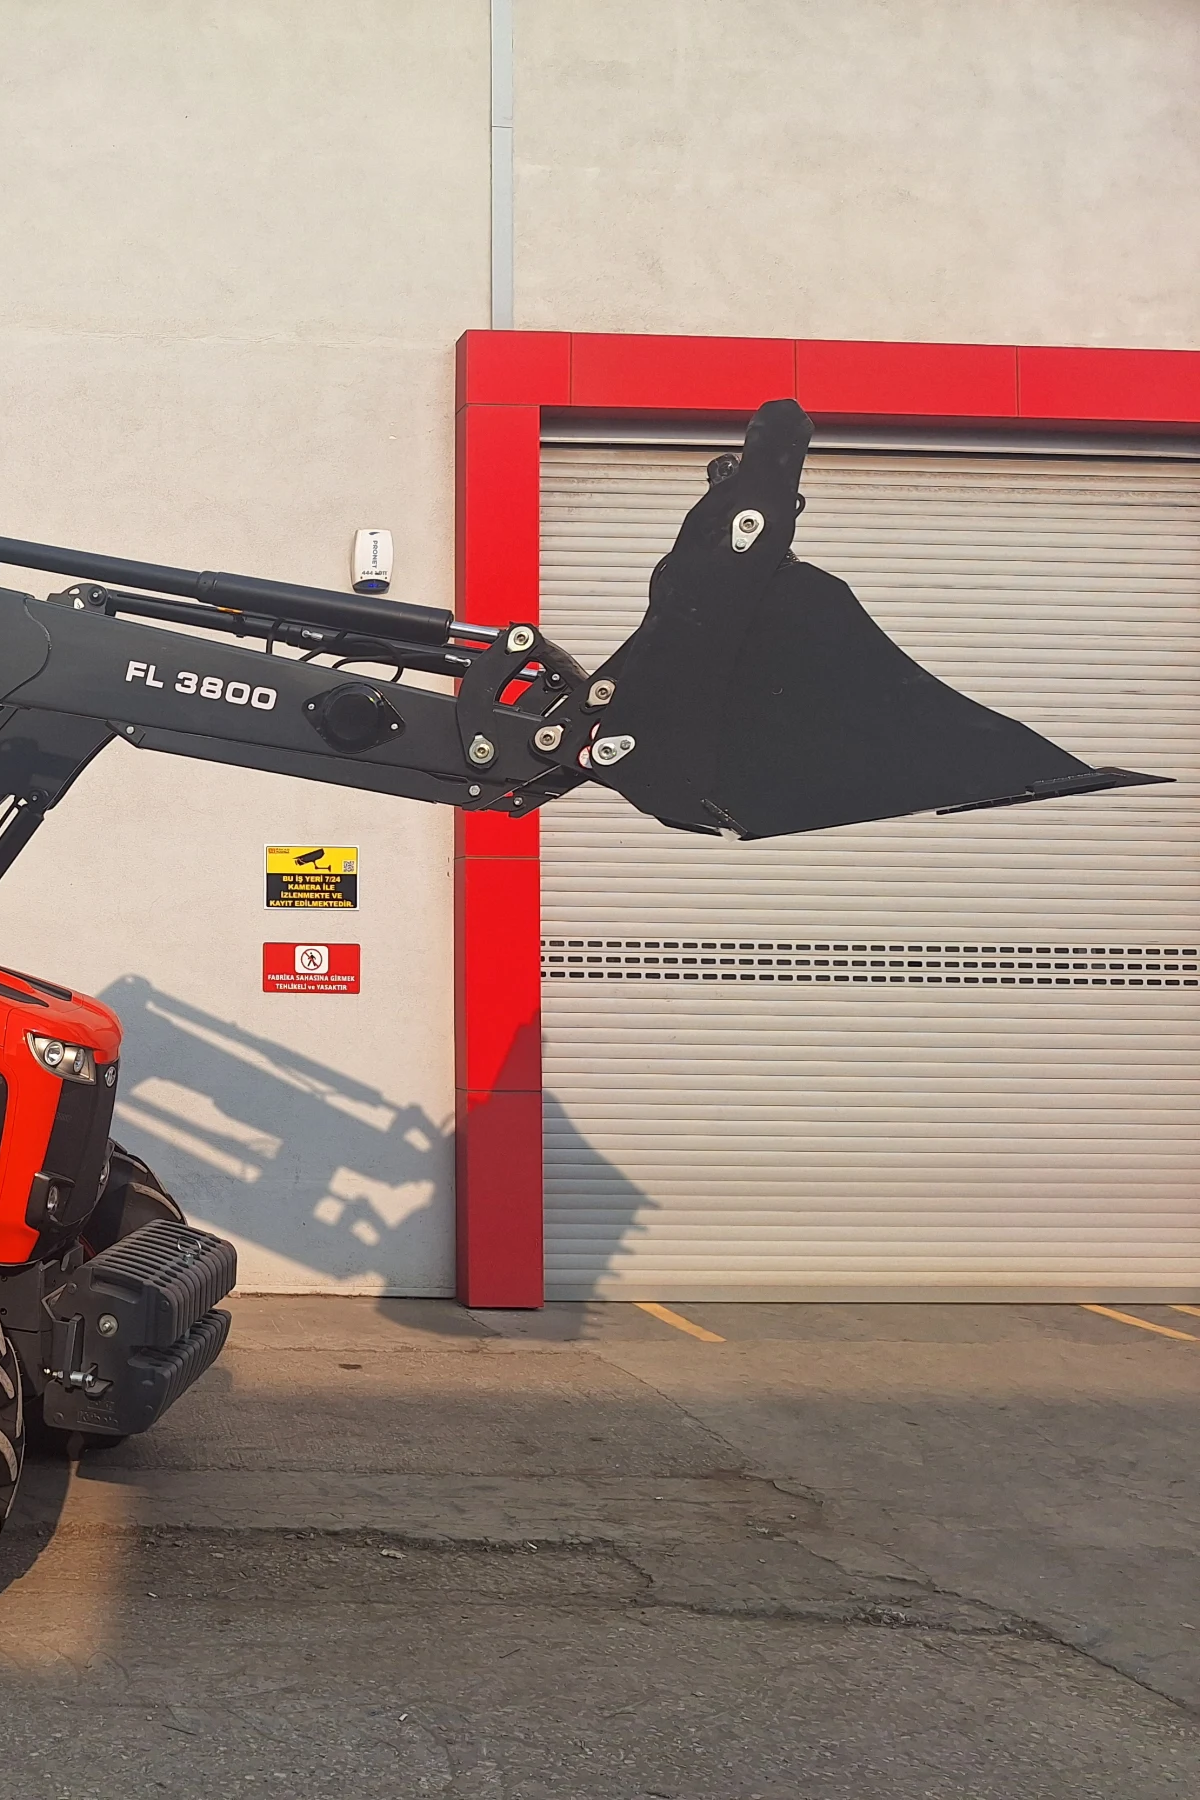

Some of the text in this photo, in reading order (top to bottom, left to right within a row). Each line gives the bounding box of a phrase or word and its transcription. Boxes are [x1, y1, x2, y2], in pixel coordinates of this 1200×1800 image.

[125, 660, 277, 711] FL 3800
[295, 874, 304, 883] İŞ
[305, 874, 323, 882] YERİ
[325, 875, 341, 883] 7/24
[288, 882, 336, 891] KAMERA İLE
[280, 891, 330, 899] İZLENMEKTE
[267, 973, 355, 982] FABRİKA SAHASINA GİRMEK
[275, 982, 307, 990] TEHLİKELİ
[316, 983, 348, 991] YASAKTIR
